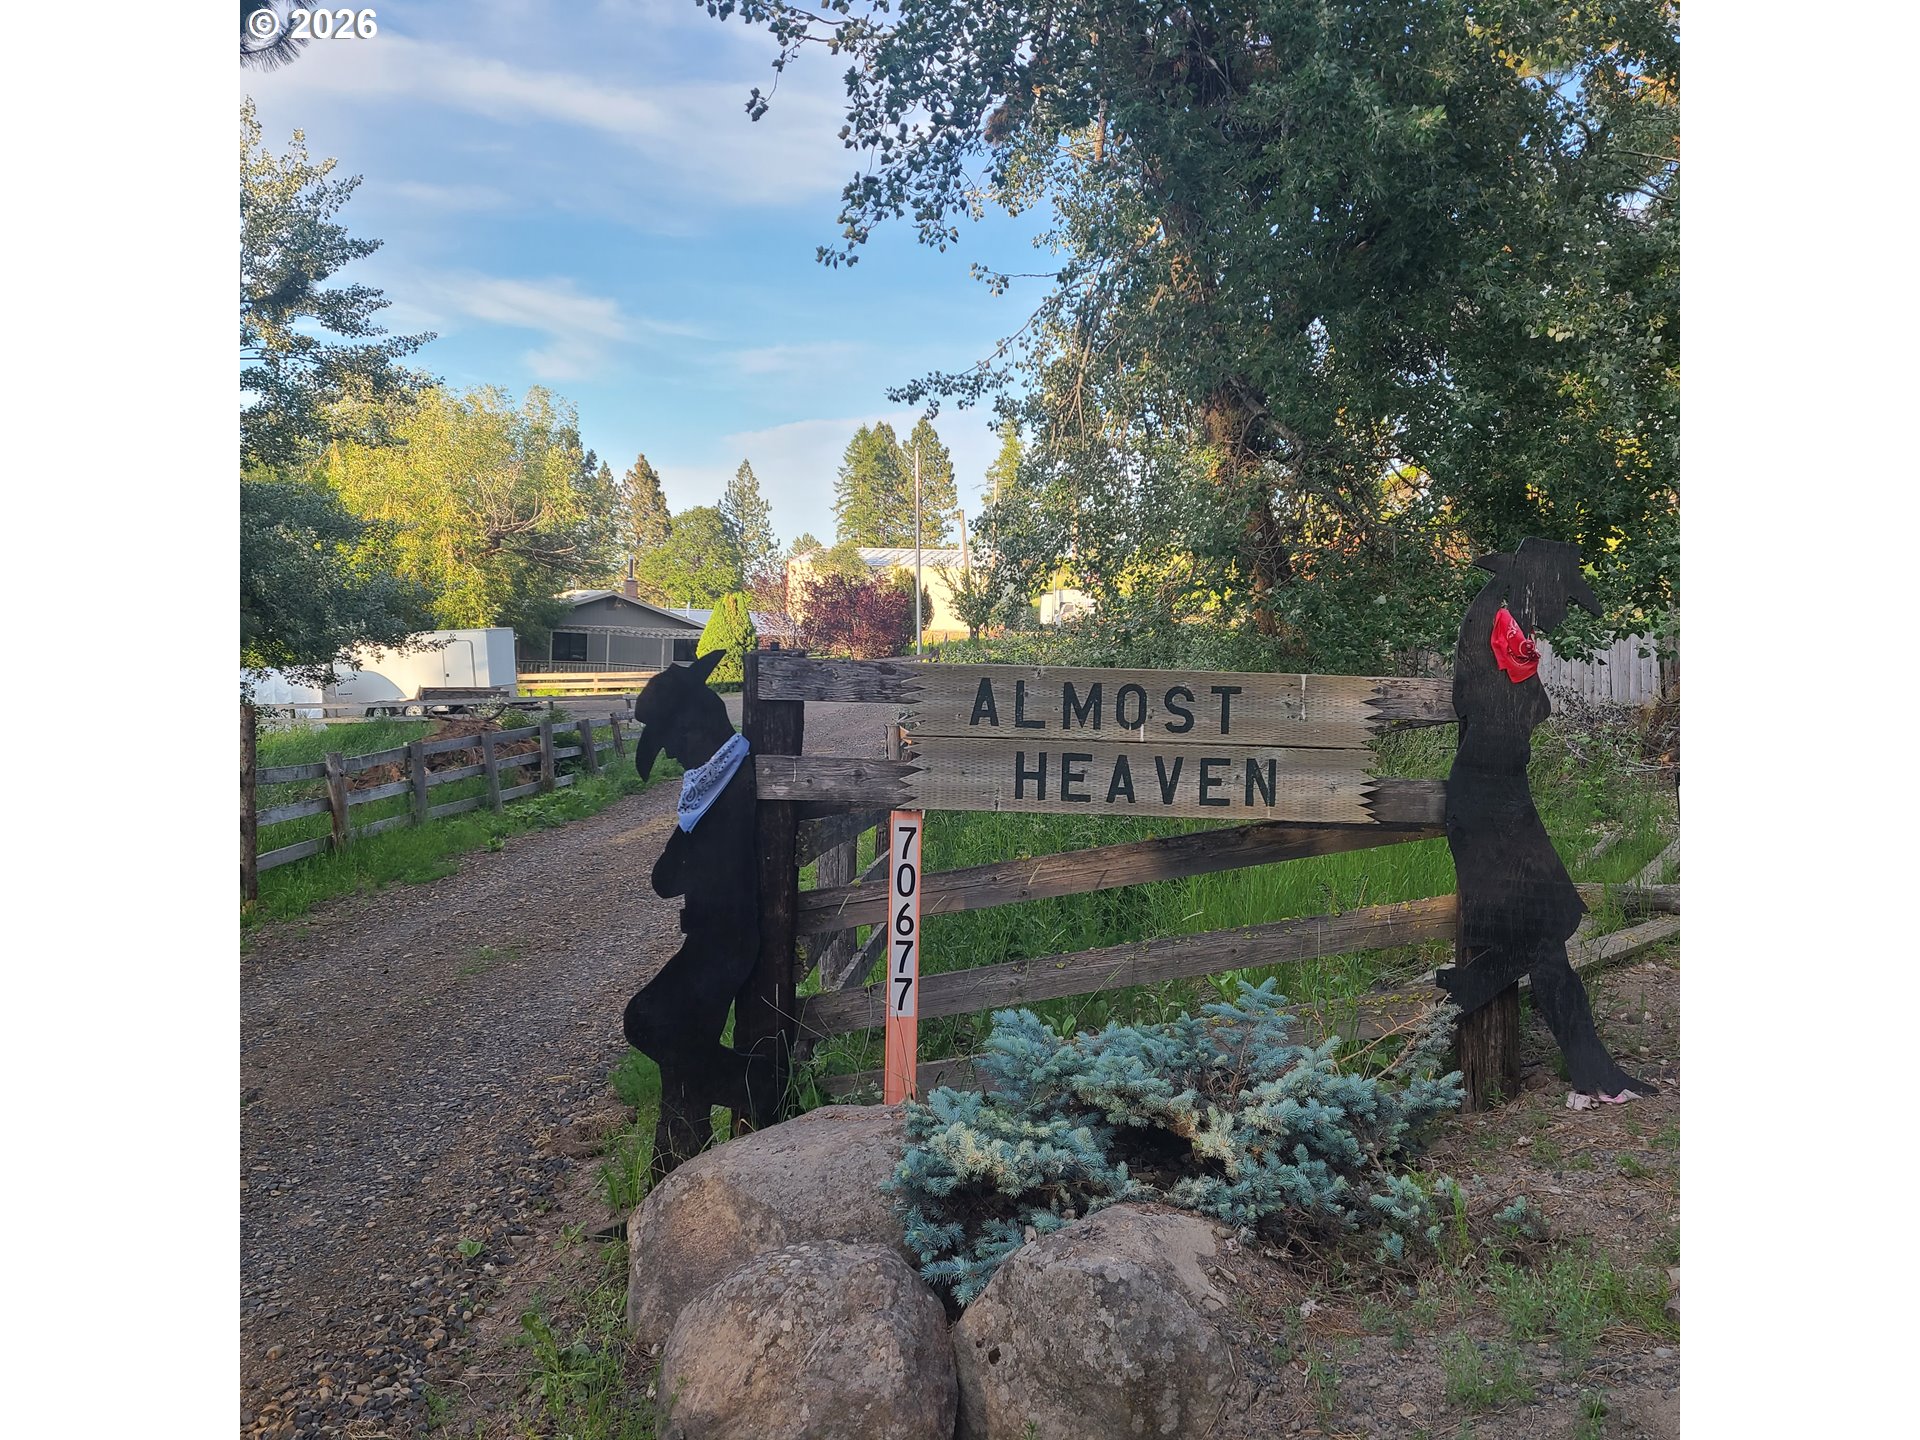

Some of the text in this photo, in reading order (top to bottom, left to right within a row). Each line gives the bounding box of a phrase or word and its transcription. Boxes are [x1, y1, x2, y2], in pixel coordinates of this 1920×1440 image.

[968, 676, 1242, 735] ALMOST
[1014, 750, 1277, 808] HEAVEN
[894, 826, 917, 1011] 70677
